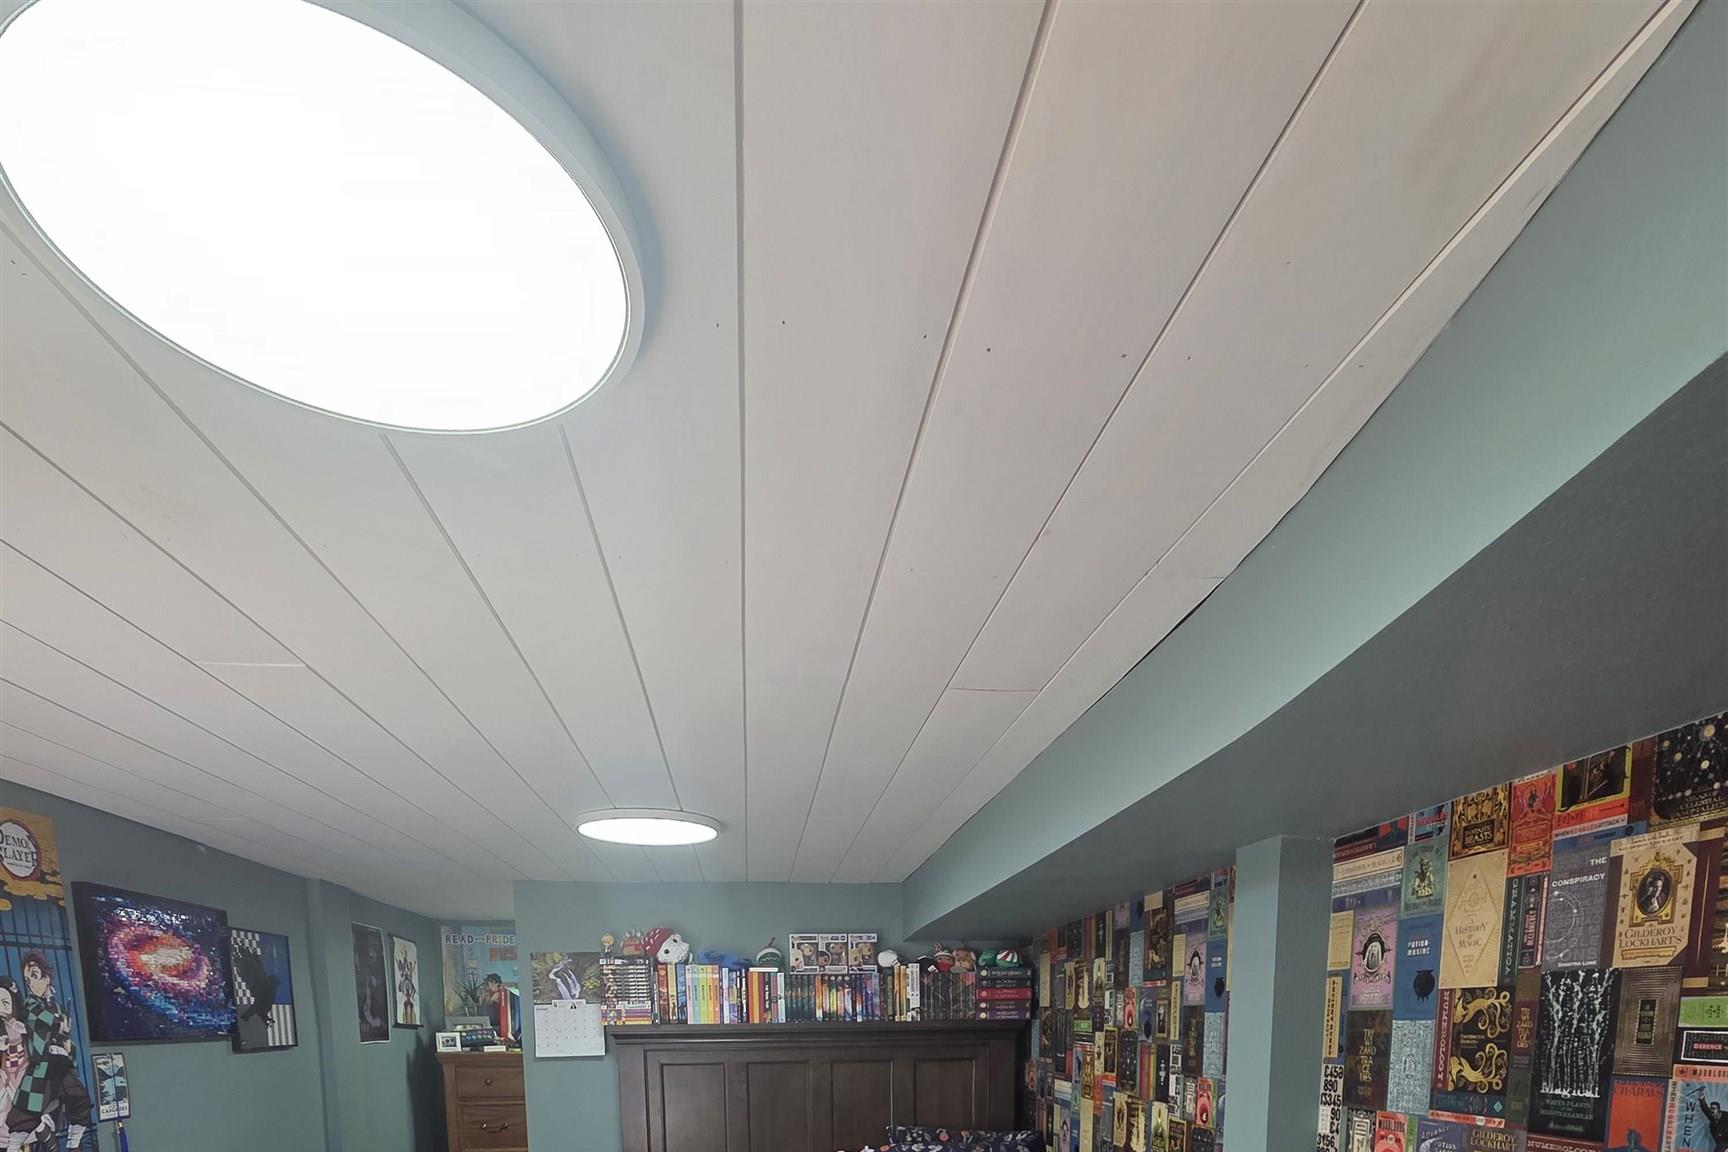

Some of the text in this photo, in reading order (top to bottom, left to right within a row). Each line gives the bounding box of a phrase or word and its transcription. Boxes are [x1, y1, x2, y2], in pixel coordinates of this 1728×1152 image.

[1590, 857, 1607, 866] THE
[1551, 873, 1606, 888] CONSPIRACY
[1624, 926, 1678, 939] GILDEROY
[445, 935, 474, 944] READ
[1618, 936, 1682, 949] LOCKHART'S
[1682, 1101, 1697, 1148] WHEN
[1472, 1129, 1516, 1143] GILDEROY
[1470, 1137, 1517, 1152] LOCKHART
